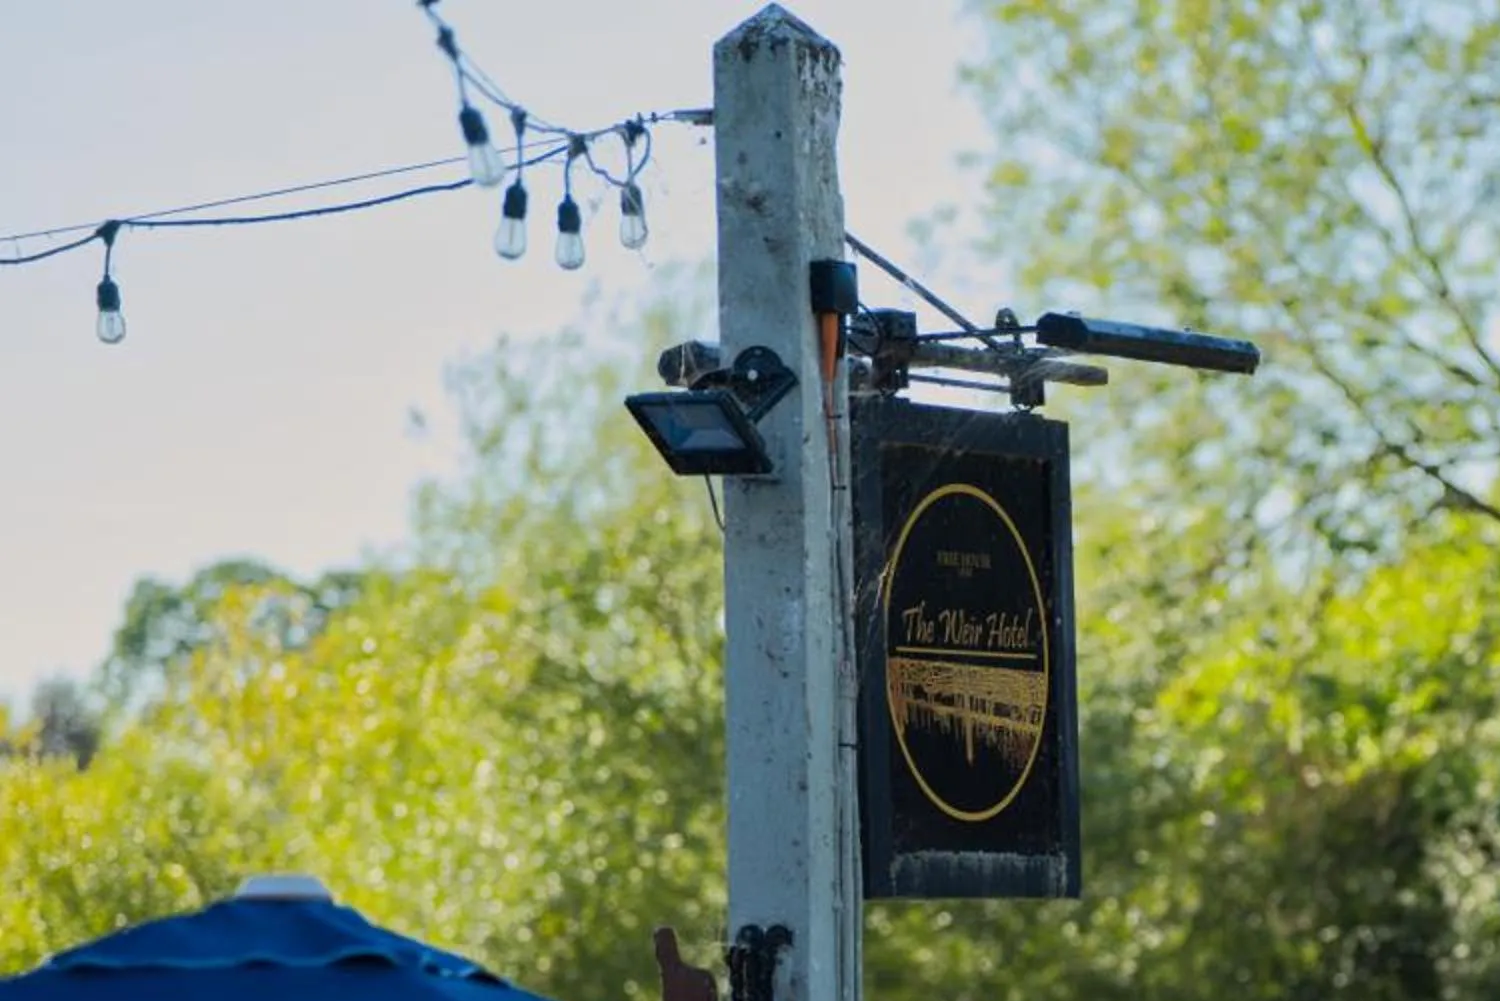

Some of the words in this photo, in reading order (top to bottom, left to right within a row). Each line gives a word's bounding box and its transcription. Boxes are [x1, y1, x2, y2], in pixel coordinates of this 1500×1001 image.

[902, 603, 935, 643] The
[938, 608, 983, 645] Weir
[985, 606, 1034, 649] Hotel
